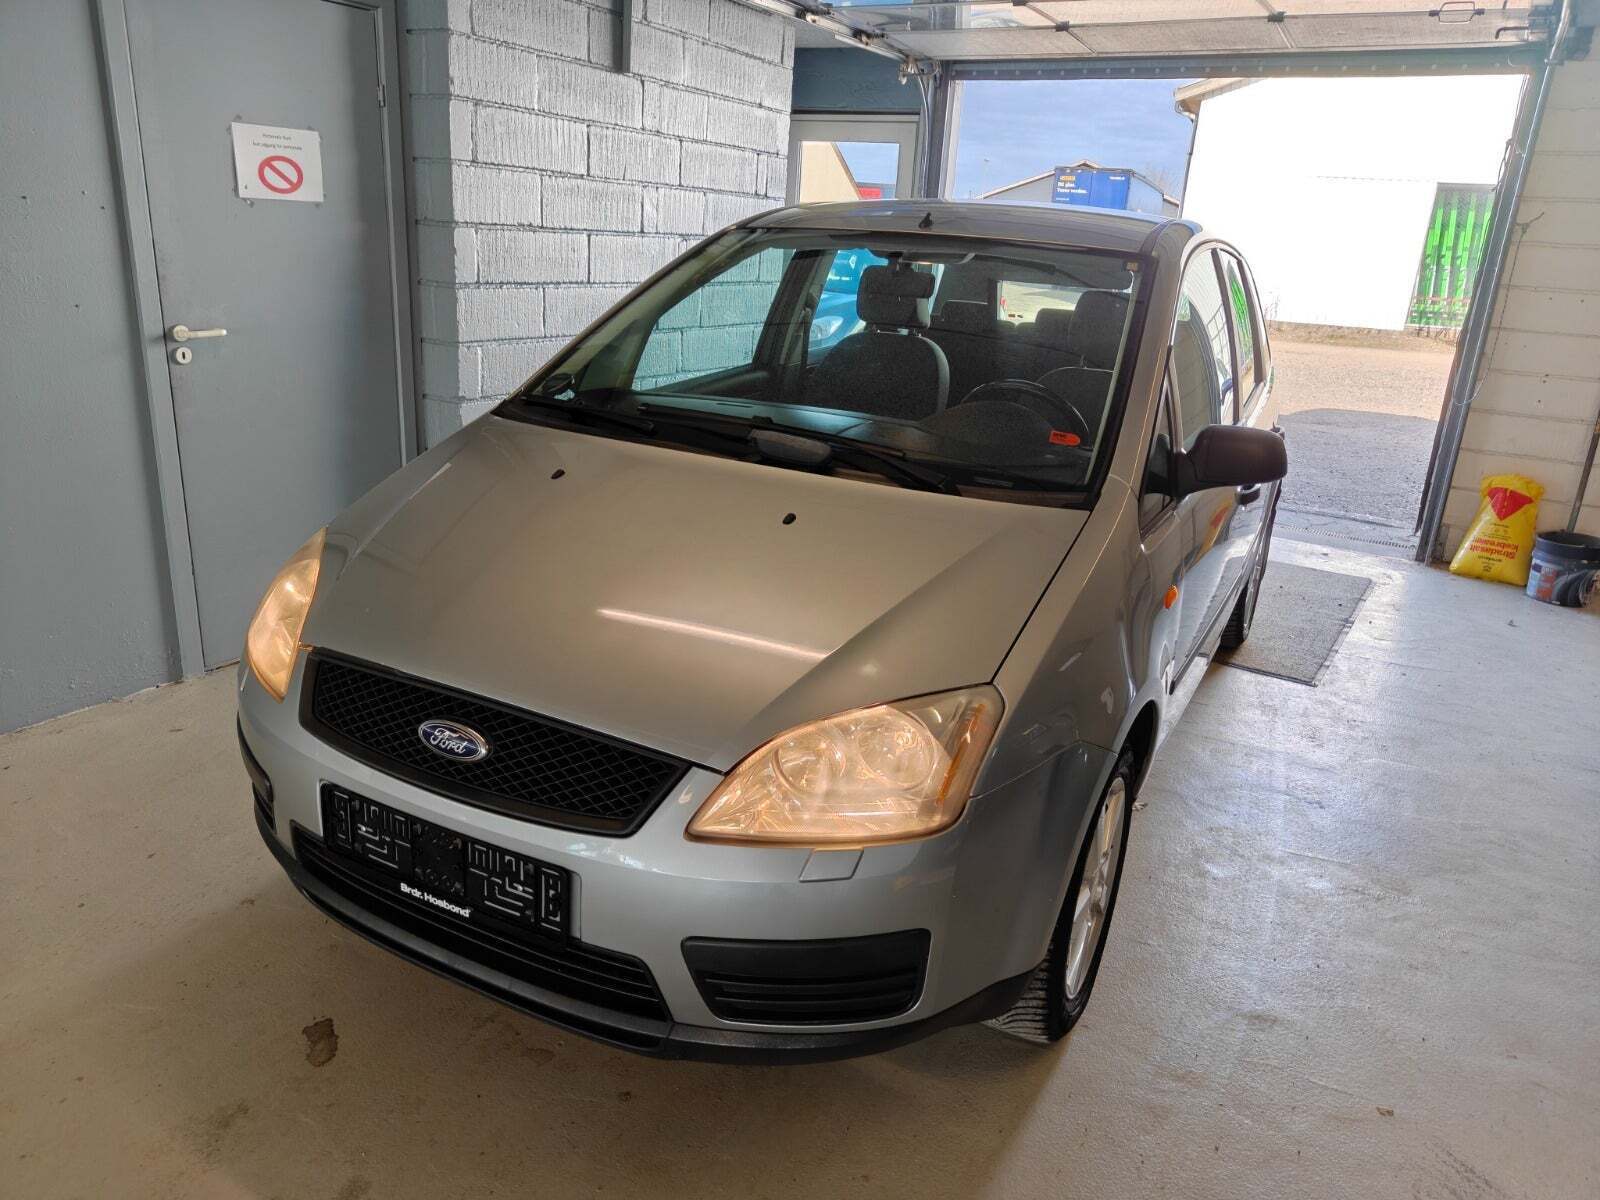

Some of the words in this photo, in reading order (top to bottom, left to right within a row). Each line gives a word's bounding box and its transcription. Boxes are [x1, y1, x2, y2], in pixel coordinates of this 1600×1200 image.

[430, 727, 468, 753] Ford
[400, 882, 423, 899] Brdr.
[424, 892, 470, 918] Hosbond
